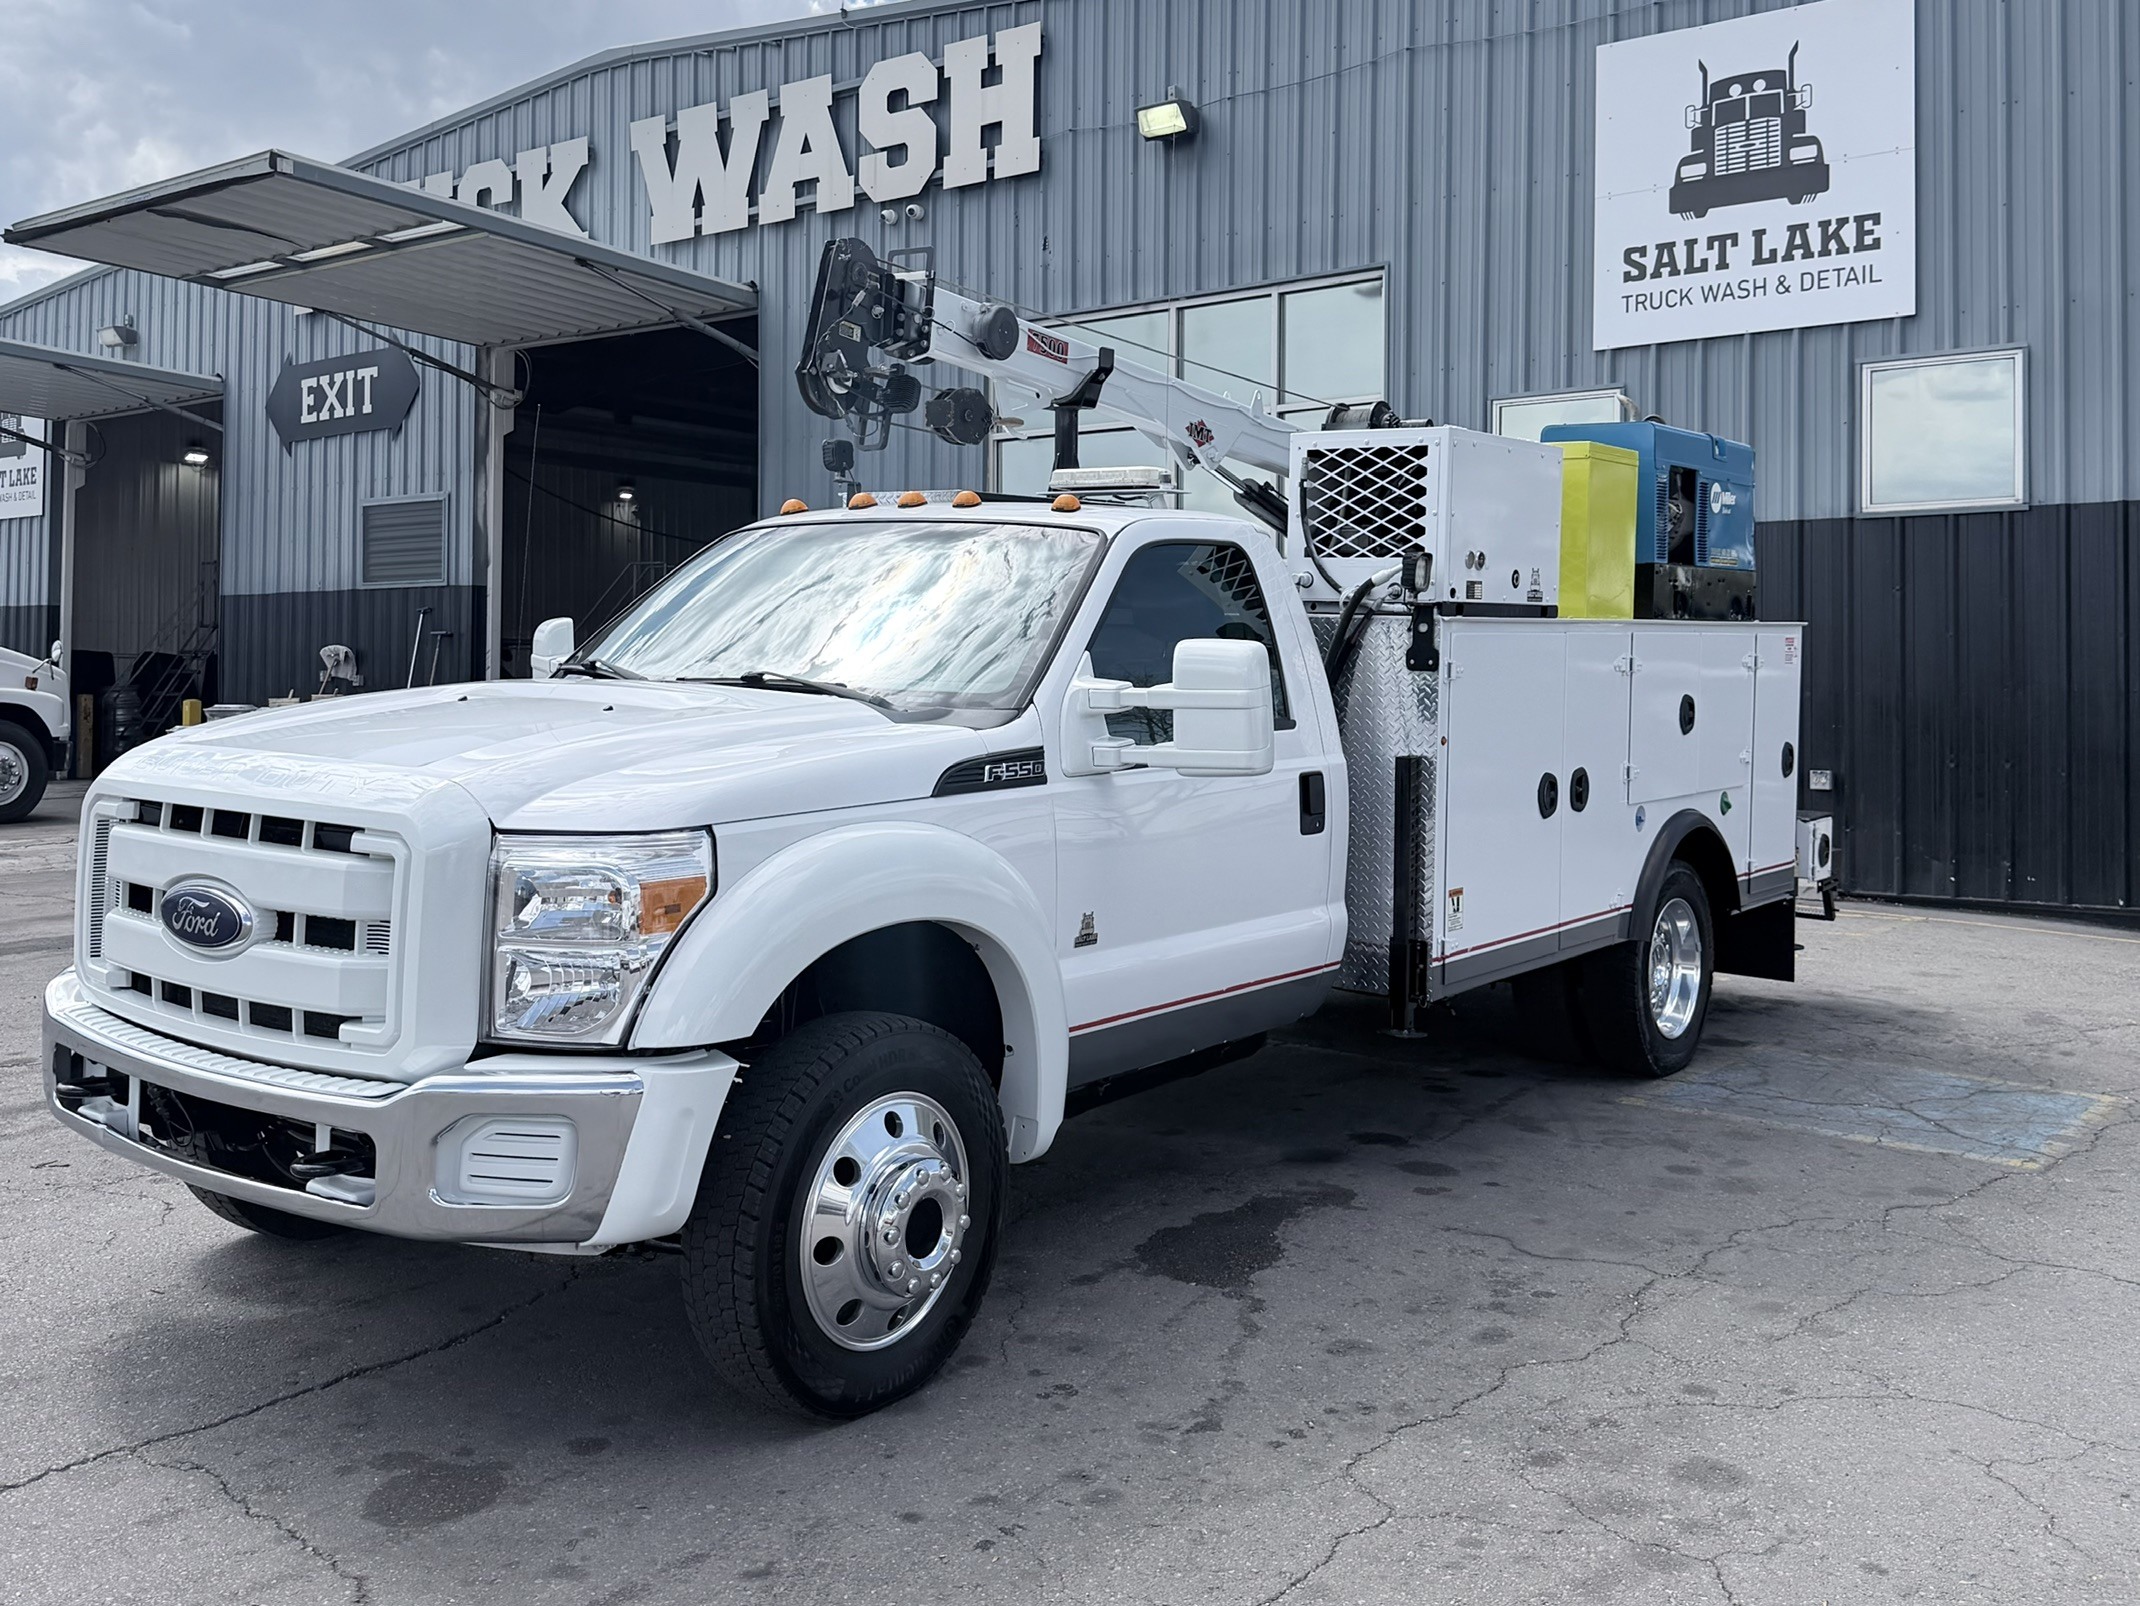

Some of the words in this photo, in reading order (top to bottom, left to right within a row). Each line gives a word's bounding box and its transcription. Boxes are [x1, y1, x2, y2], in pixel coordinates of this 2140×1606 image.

[630, 21, 1042, 246] WASH
[1622, 232, 1739, 284] SALT
[1752, 212, 1882, 267] LAKE
[1621, 287, 1694, 313] TRUCK
[1700, 277, 1768, 304] WASH
[1775, 274, 1792, 295] &
[1800, 264, 1883, 292] DETAIL
[1032, 331, 1064, 360] 7500
[300, 365, 379, 424] EXIT
[9, 466, 37, 487] LAKE
[172, 896, 221, 938] Ford
